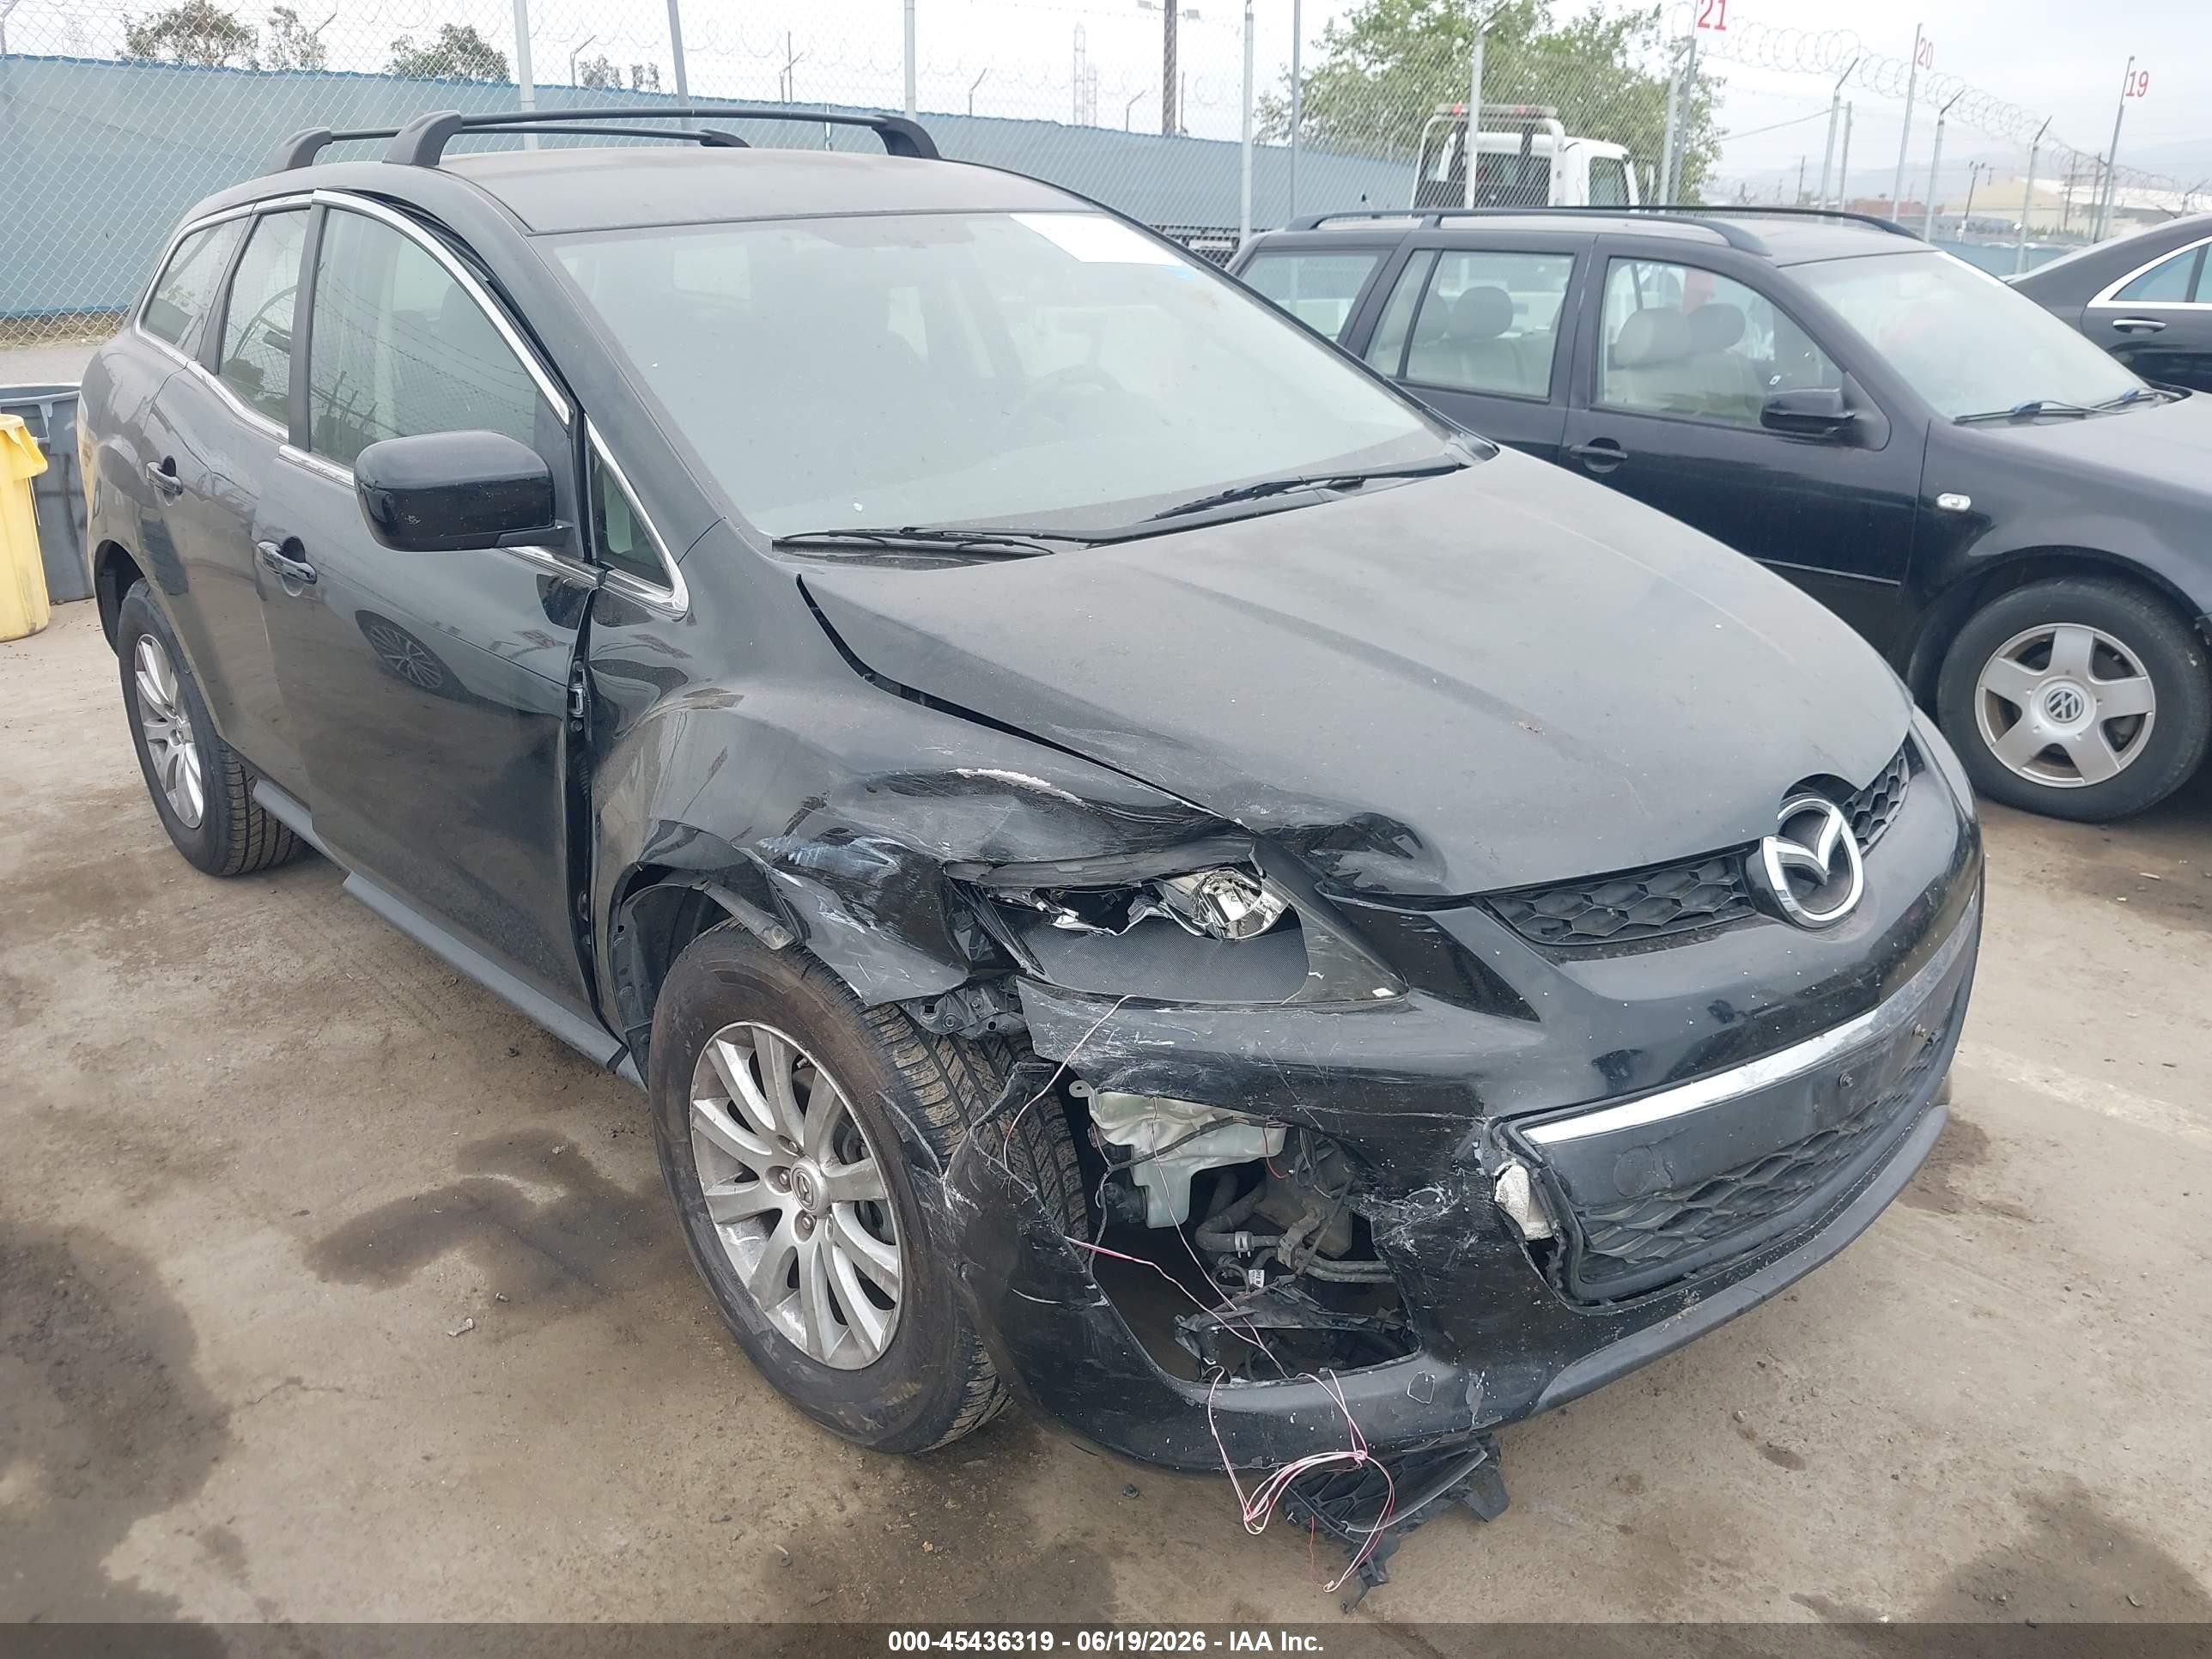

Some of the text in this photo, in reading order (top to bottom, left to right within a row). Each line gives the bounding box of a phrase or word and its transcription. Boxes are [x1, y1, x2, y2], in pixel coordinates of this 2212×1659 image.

[1697, 0, 1727, 31] 21
[1917, 37, 1934, 70] 20
[2124, 70, 2149, 98] 19
